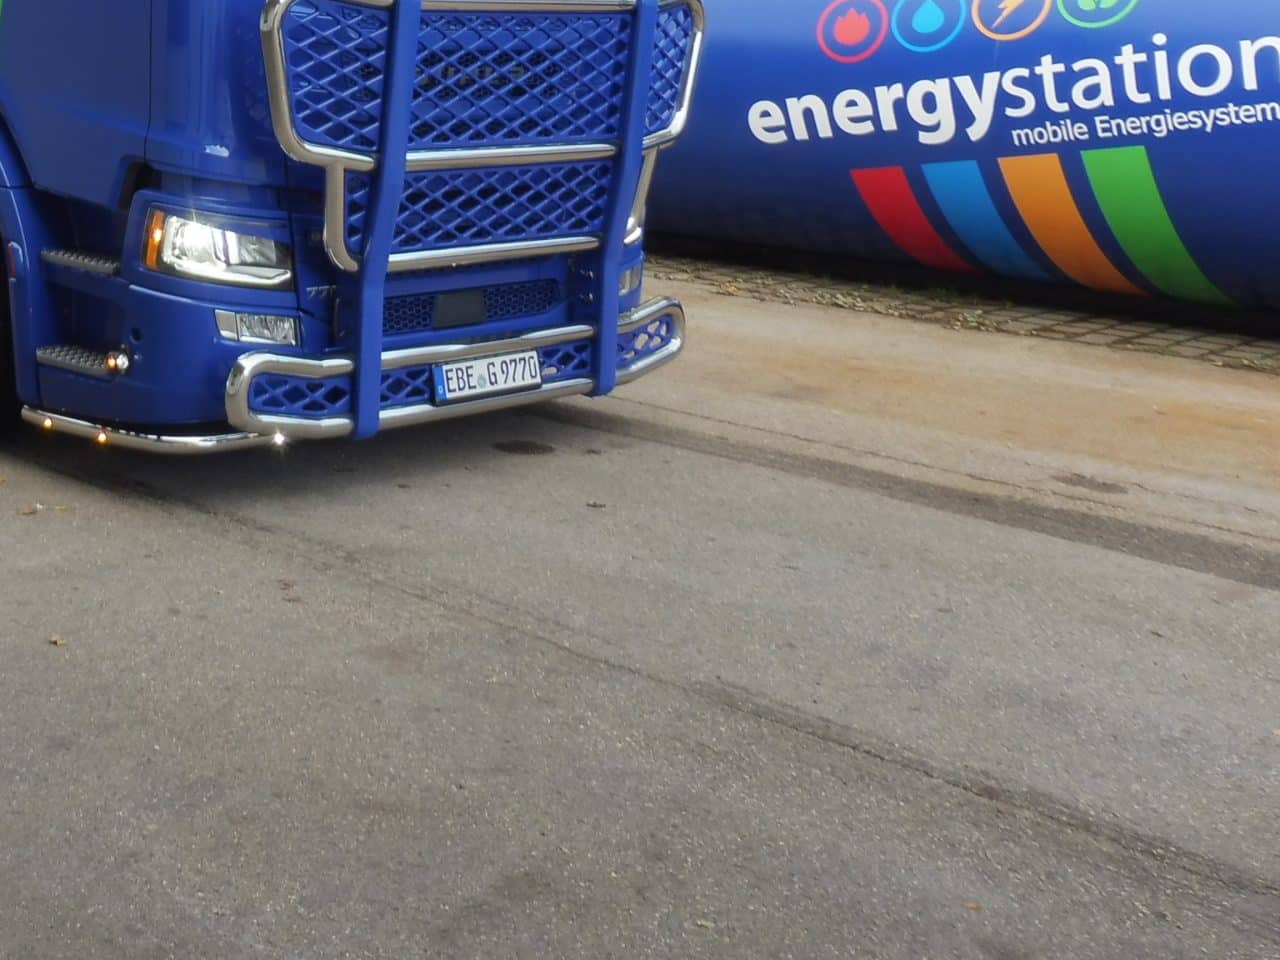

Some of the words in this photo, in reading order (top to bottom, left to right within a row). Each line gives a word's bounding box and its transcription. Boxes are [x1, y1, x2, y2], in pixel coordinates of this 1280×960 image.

[748, 33, 1280, 145] energystation
[1012, 115, 1089, 147] mobile
[445, 366, 477, 393] EBE
[487, 361, 498, 386] G
[500, 355, 537, 384] 9770
